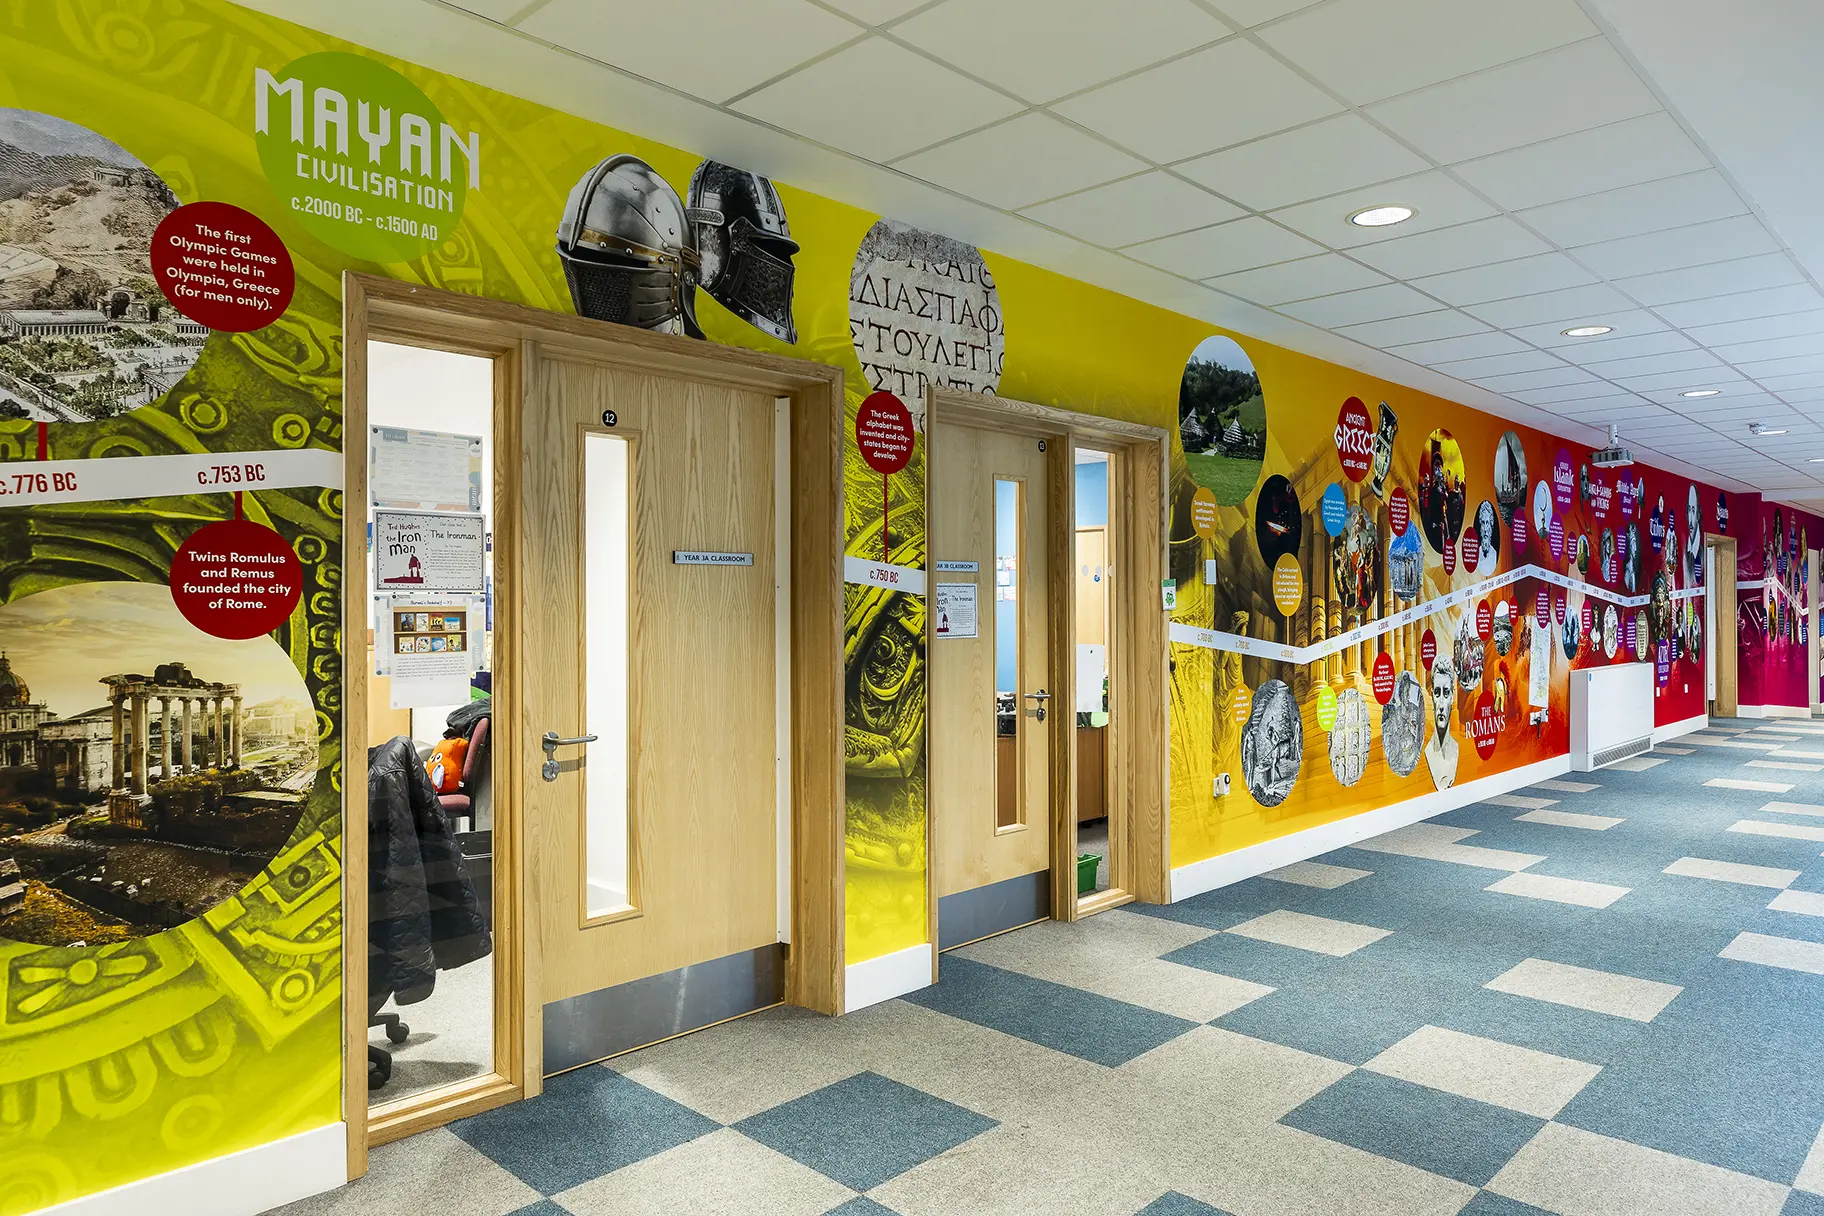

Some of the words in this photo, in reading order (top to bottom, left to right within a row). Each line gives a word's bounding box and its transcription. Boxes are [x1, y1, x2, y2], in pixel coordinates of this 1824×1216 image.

[255, 67, 480, 191] MAYAN
[297, 153, 453, 213] CIVILISATION
[291, 196, 341, 220] c.2000
[345, 205, 363, 224] BC
[376, 215, 418, 237] c.1500
[421, 223, 438, 241] AD
[196, 224, 221, 239] The
[224, 230, 251, 244] first
[170, 236, 227, 256] Olympic
[231, 247, 277, 265] Games
[183, 256, 217, 269] were
[221, 260, 250, 275] held
[253, 266, 265, 278] in
[167, 267, 229, 289] Olympia,
[233, 279, 280, 295] Greece
[175, 284, 200, 298] (for
[204, 291, 233, 303] men
[237, 296, 273, 311] only).
[605, 413, 615, 424] 12
[871, 410, 881, 418] The
[882, 412, 899, 421] Greek
[866, 420, 892, 429] alphabet
[860, 429, 884, 439] invented
[1334, 424, 1376, 457] GREECE
[864, 440, 881, 448] states
[882, 441, 900, 451] began
[874, 451, 898, 461] develop.
[198, 466, 241, 485] c.753
[245, 464, 266, 482] BC
[0, 473, 48, 495] c.776
[53, 472, 77, 492] BC
[398, 531, 422, 543] Iron
[430, 530, 444, 539] The
[189, 551, 226, 562] Twins
[231, 552, 286, 564] Romulus
[201, 568, 228, 579] and
[232, 568, 275, 579] Remus
[870, 569, 889, 582] c.750
[890, 572, 899, 584] BC
[183, 583, 240, 594] founded
[244, 583, 265, 594] the
[268, 584, 291, 597] city
[209, 599, 223, 609] of
[226, 599, 267, 610] Rome.
[1481, 706, 1491, 717] THE
[1465, 715, 1506, 739] ROMANS
